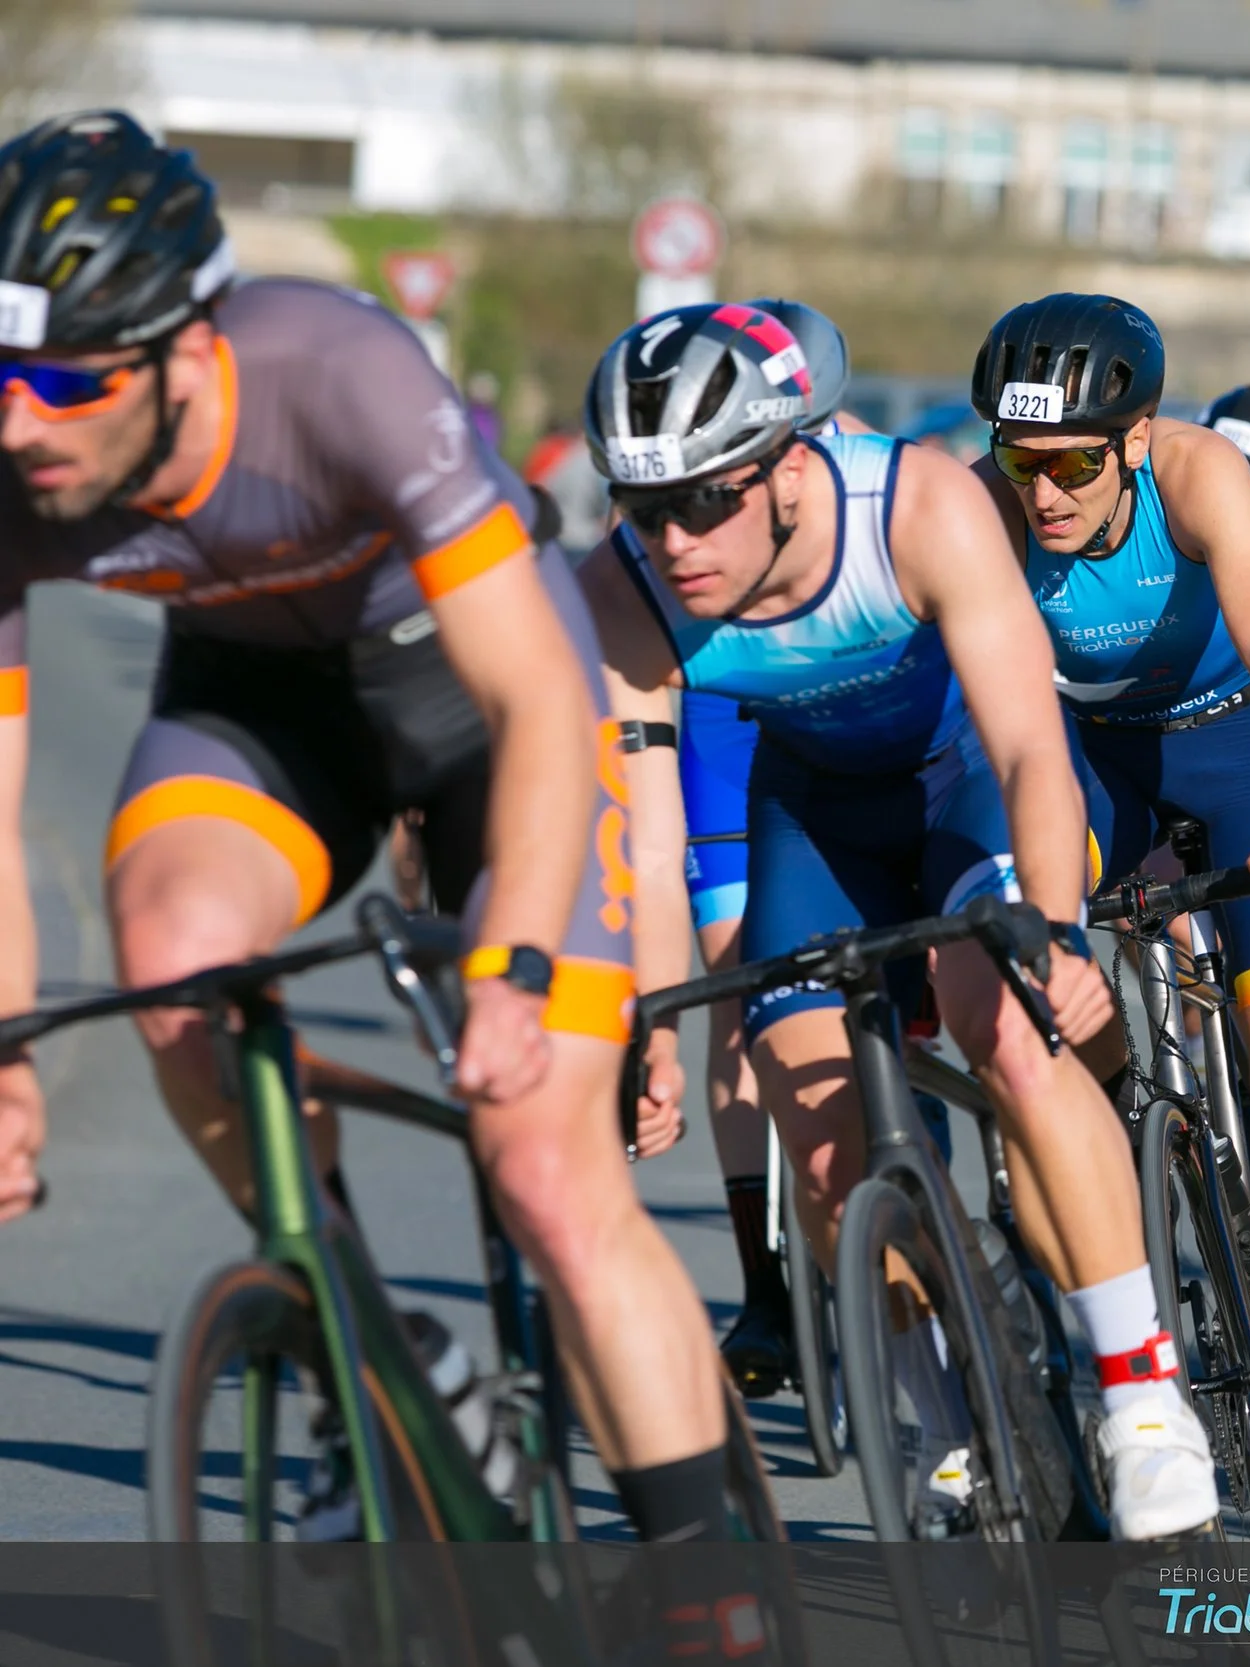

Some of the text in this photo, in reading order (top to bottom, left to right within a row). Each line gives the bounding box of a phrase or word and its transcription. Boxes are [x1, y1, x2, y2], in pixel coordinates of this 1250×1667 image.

[1009, 394, 1049, 418] 3221
[619, 450, 666, 478] 3176
[1059, 613, 1179, 641] PÉRIGUEUX
[1062, 634, 1155, 653] Triathlon
